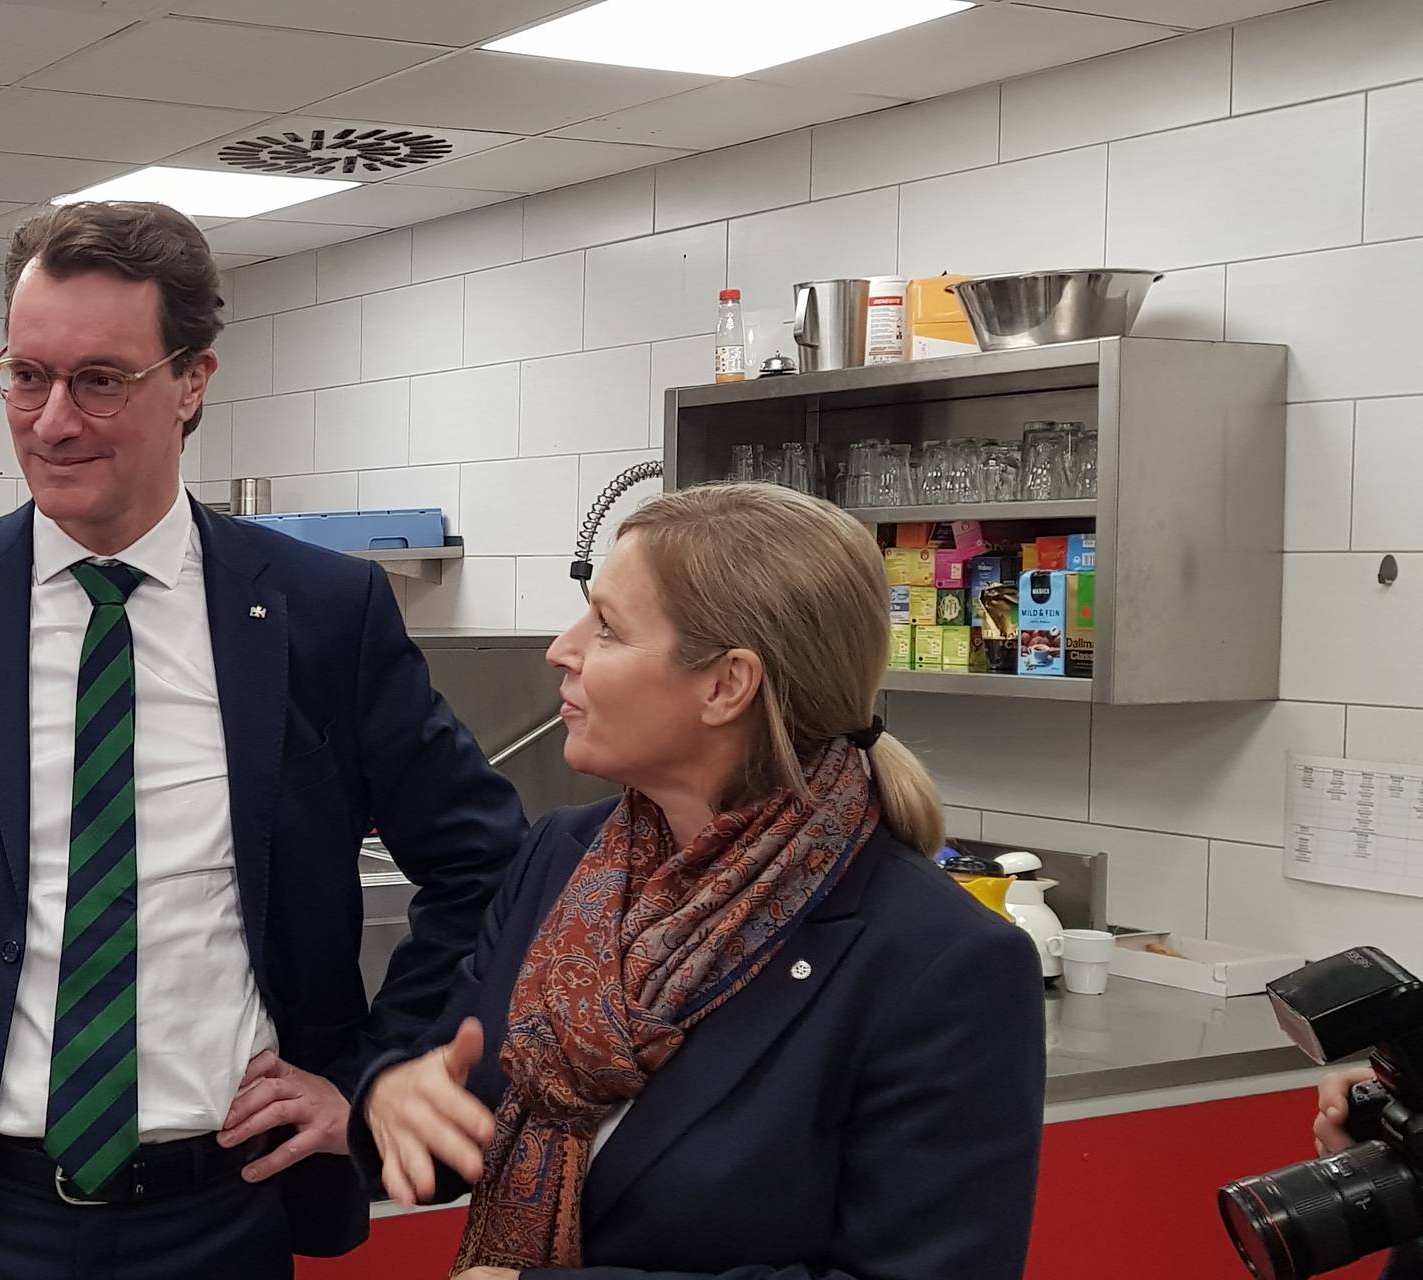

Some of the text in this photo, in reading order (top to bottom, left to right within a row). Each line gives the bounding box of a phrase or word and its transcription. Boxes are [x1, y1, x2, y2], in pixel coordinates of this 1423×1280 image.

[1021, 608, 1060, 617] MILD & FEIN
